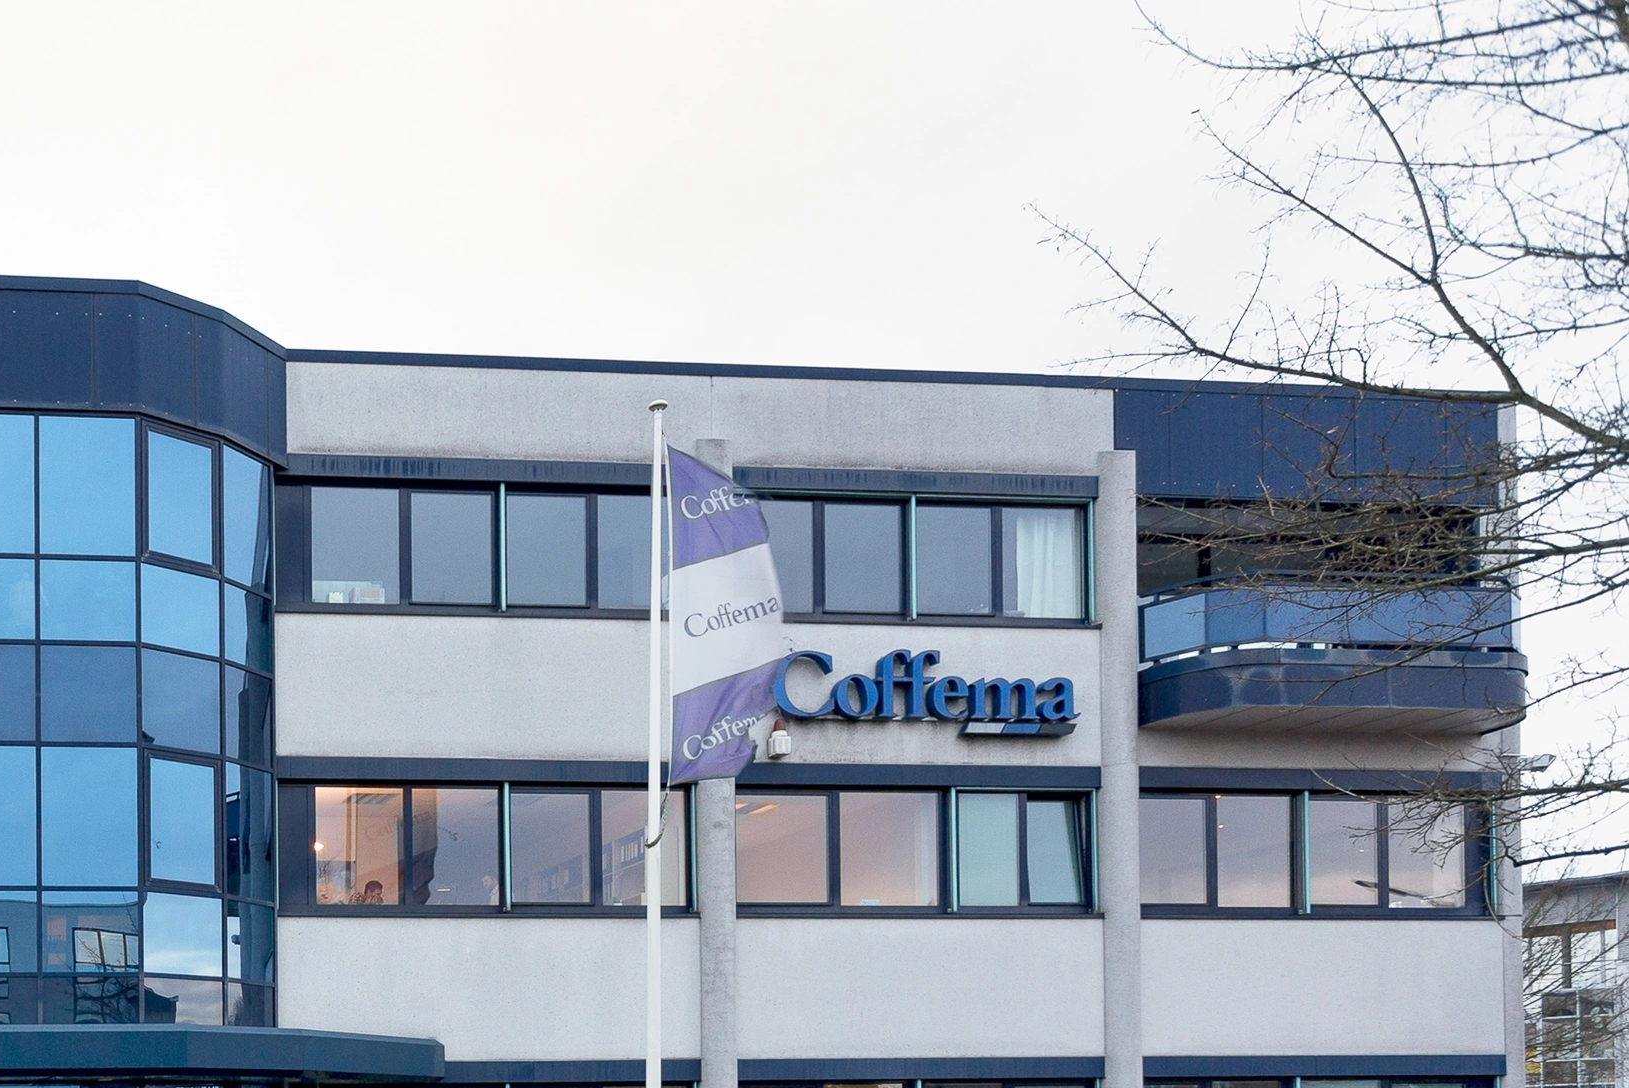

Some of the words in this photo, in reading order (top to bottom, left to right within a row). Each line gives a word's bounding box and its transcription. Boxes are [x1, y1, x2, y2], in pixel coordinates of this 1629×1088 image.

[683, 593, 780, 638] Coffema
[773, 648, 1081, 723] Coffema
[682, 714, 766, 760] Coffem
